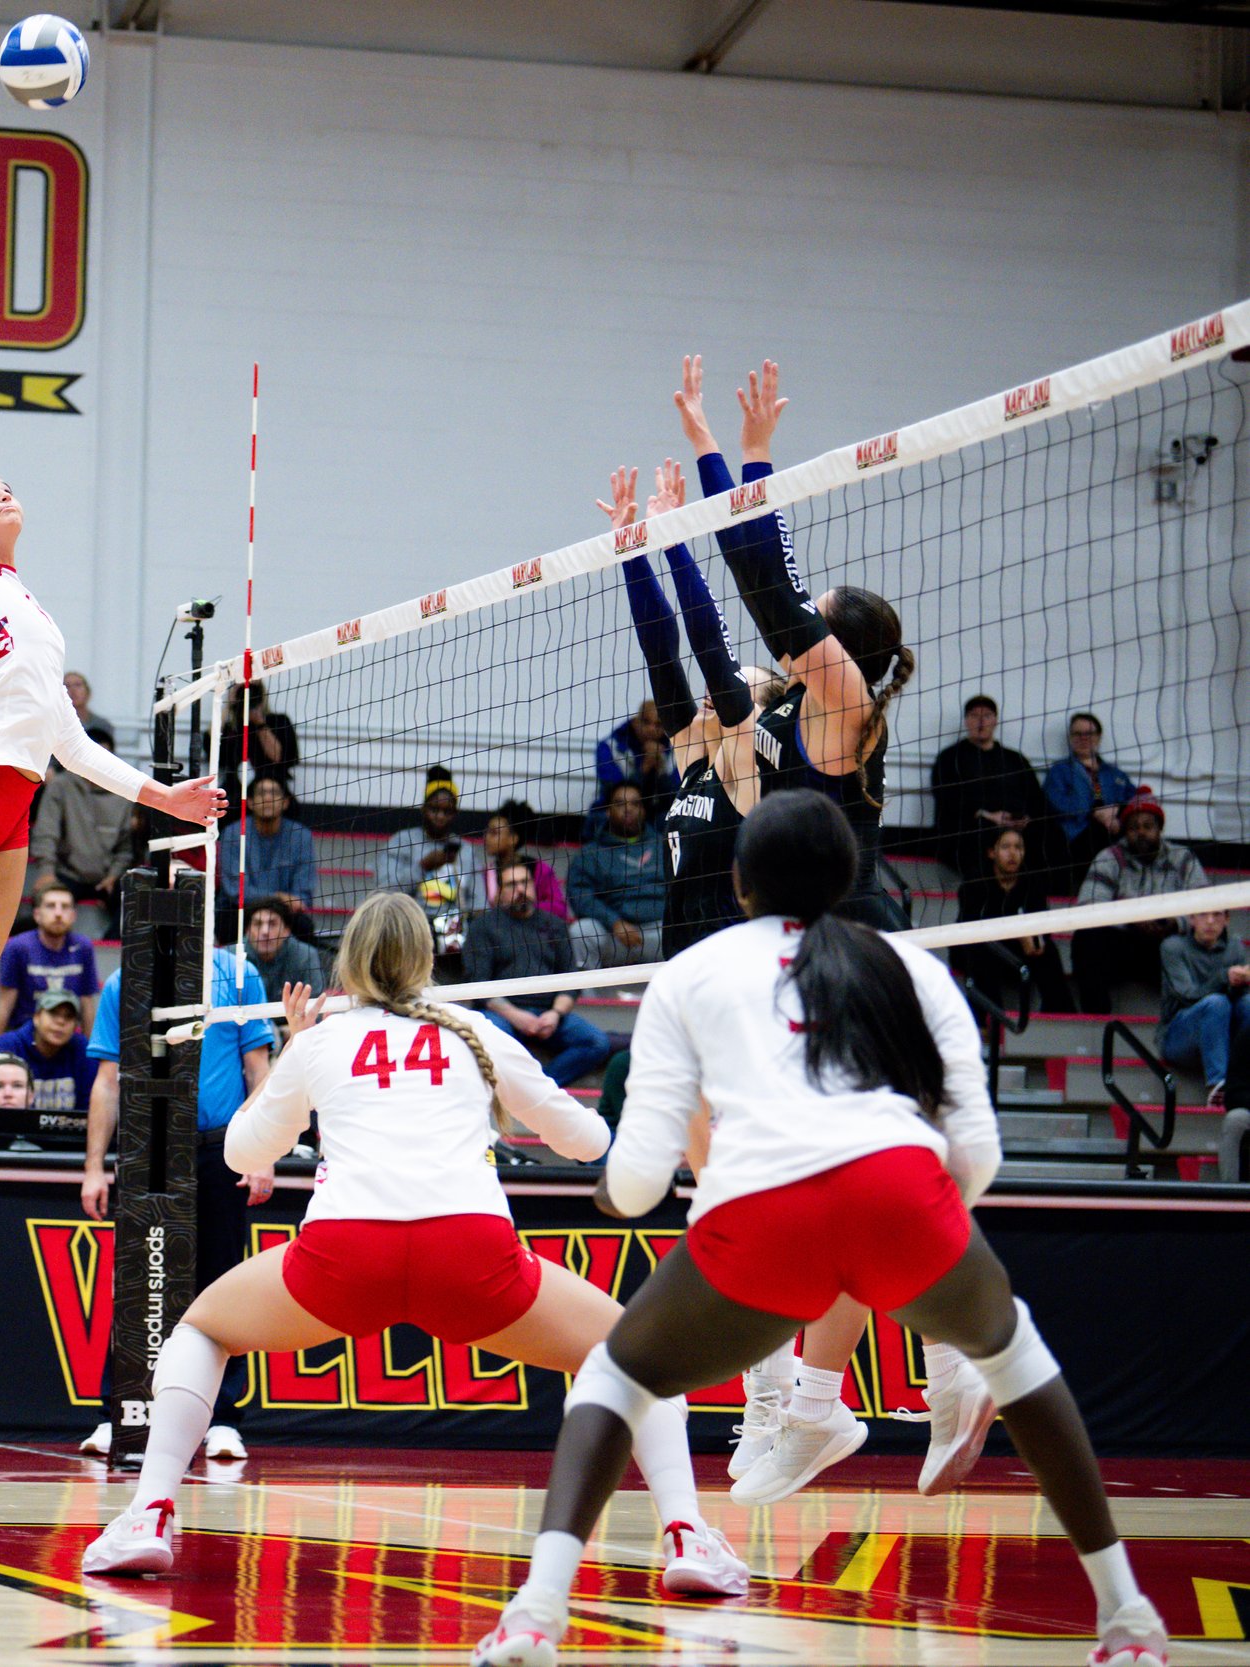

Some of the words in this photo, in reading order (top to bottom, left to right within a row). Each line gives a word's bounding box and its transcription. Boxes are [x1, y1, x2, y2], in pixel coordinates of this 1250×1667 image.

[1171, 312, 1224, 354] MARYLAND
[1005, 378, 1051, 416] MARYLAND
[856, 432, 898, 463] MARYLAND
[730, 479, 767, 511] MARYLAND
[351, 1023, 450, 1089] 44
[145, 1226, 165, 1290] sports
